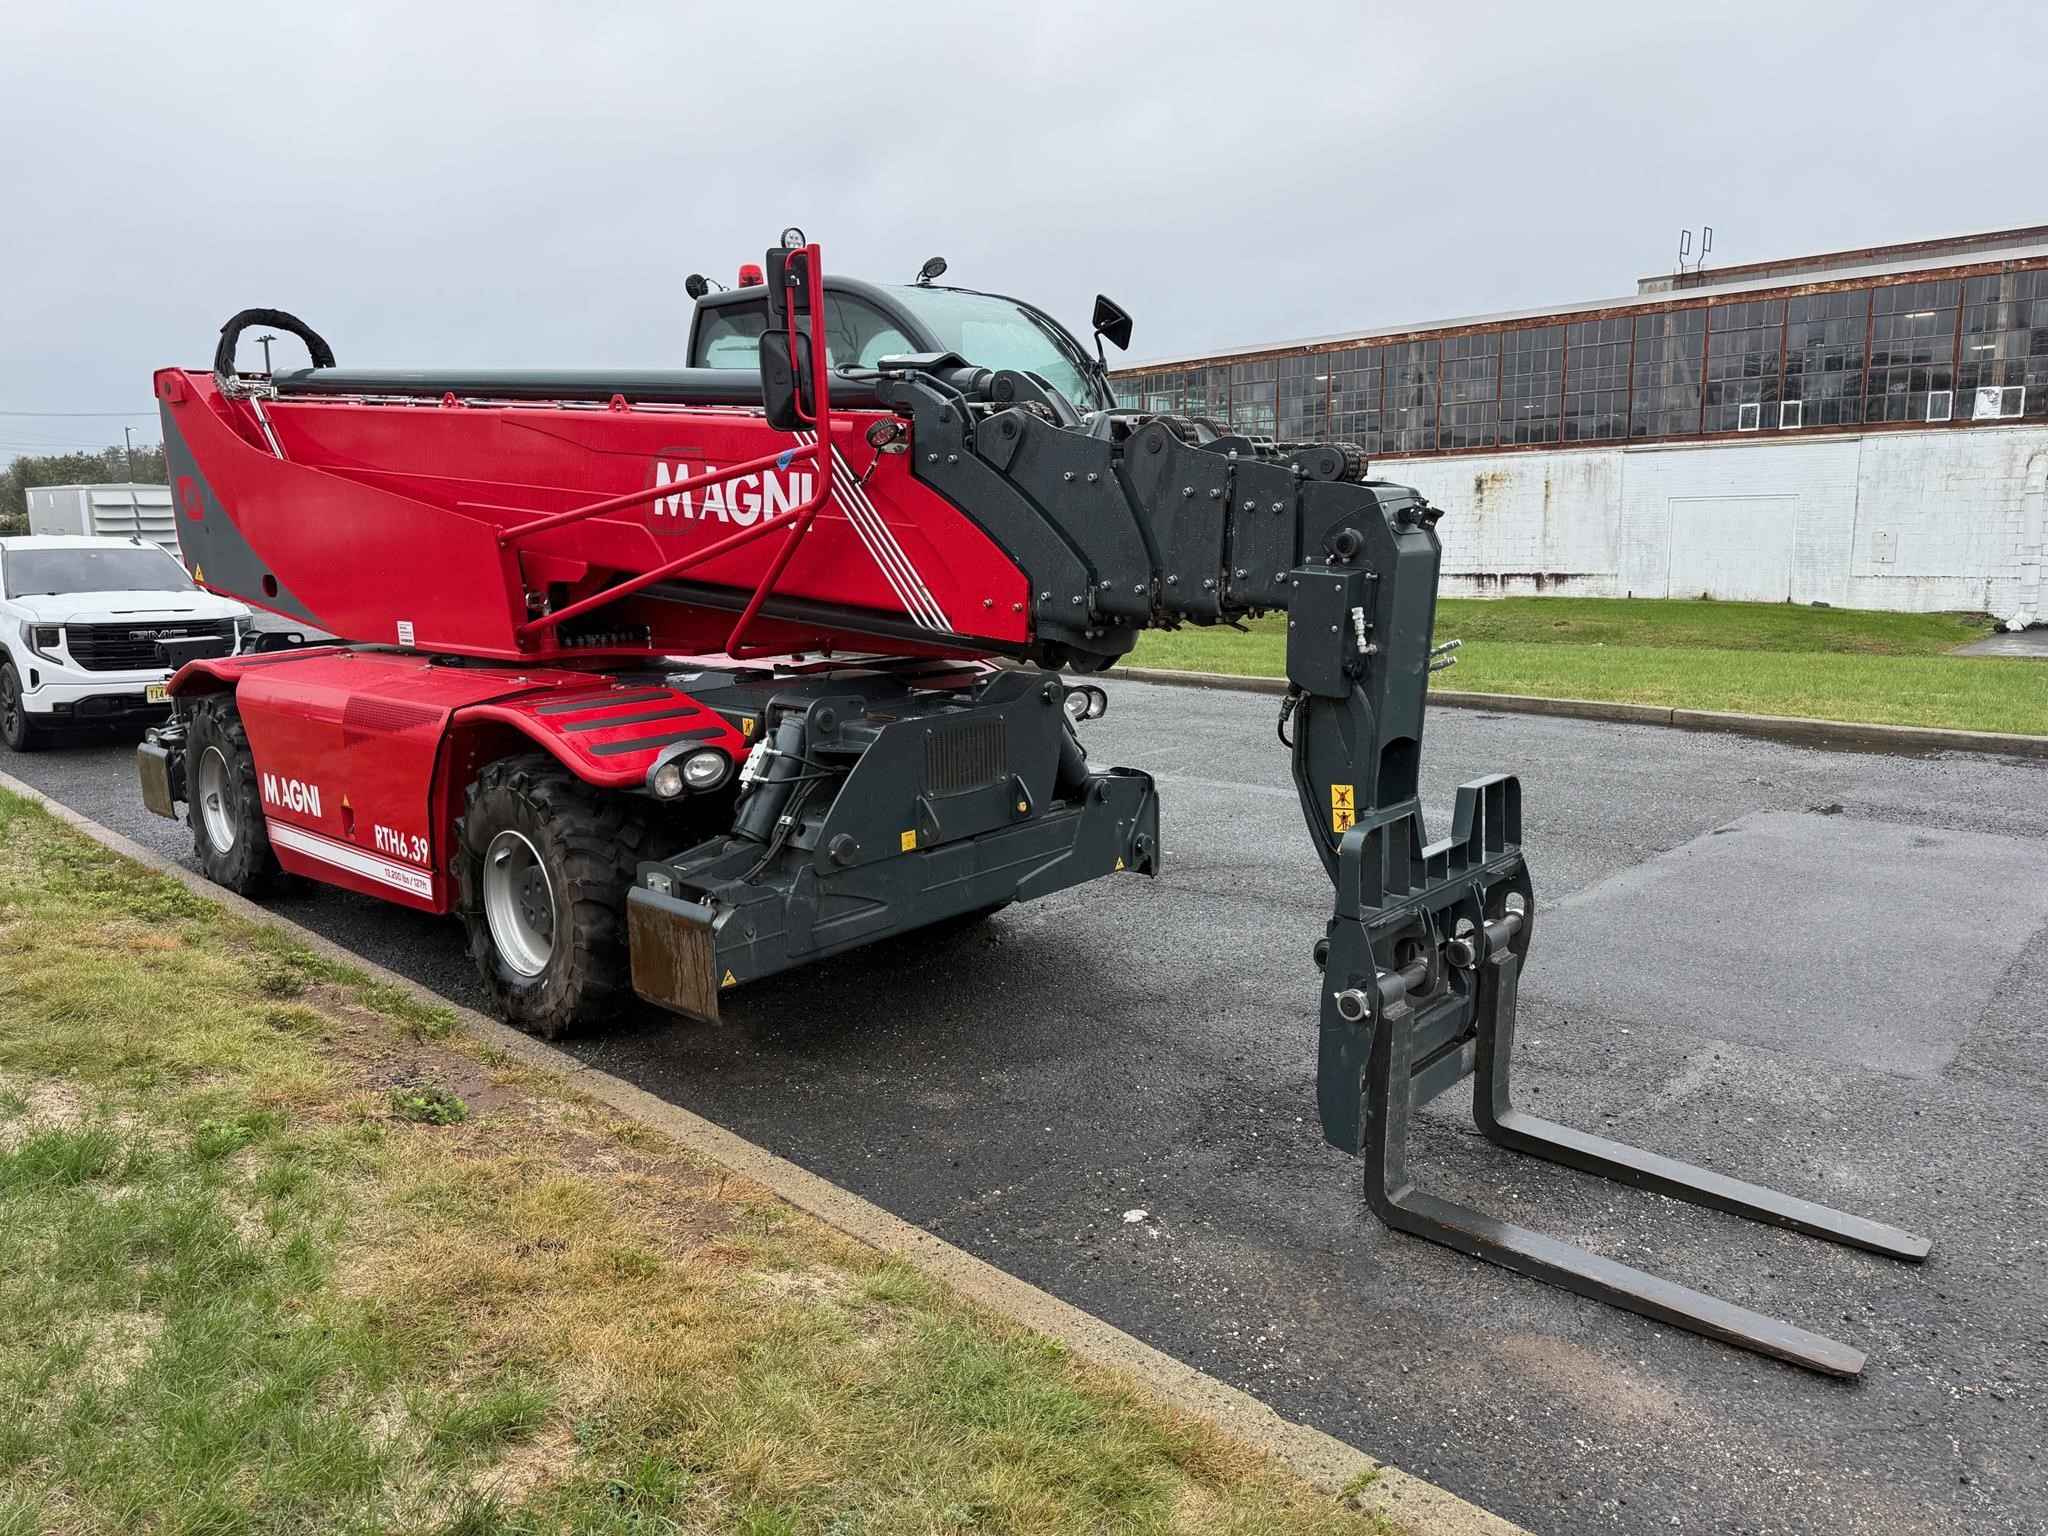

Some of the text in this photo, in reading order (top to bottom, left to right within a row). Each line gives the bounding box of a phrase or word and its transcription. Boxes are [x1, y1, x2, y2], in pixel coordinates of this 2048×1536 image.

[654, 462, 813, 532] MAGNI
[129, 629, 188, 640] GMC
[263, 772, 321, 817] MAGNI
[374, 824, 428, 864] RTH6.39
